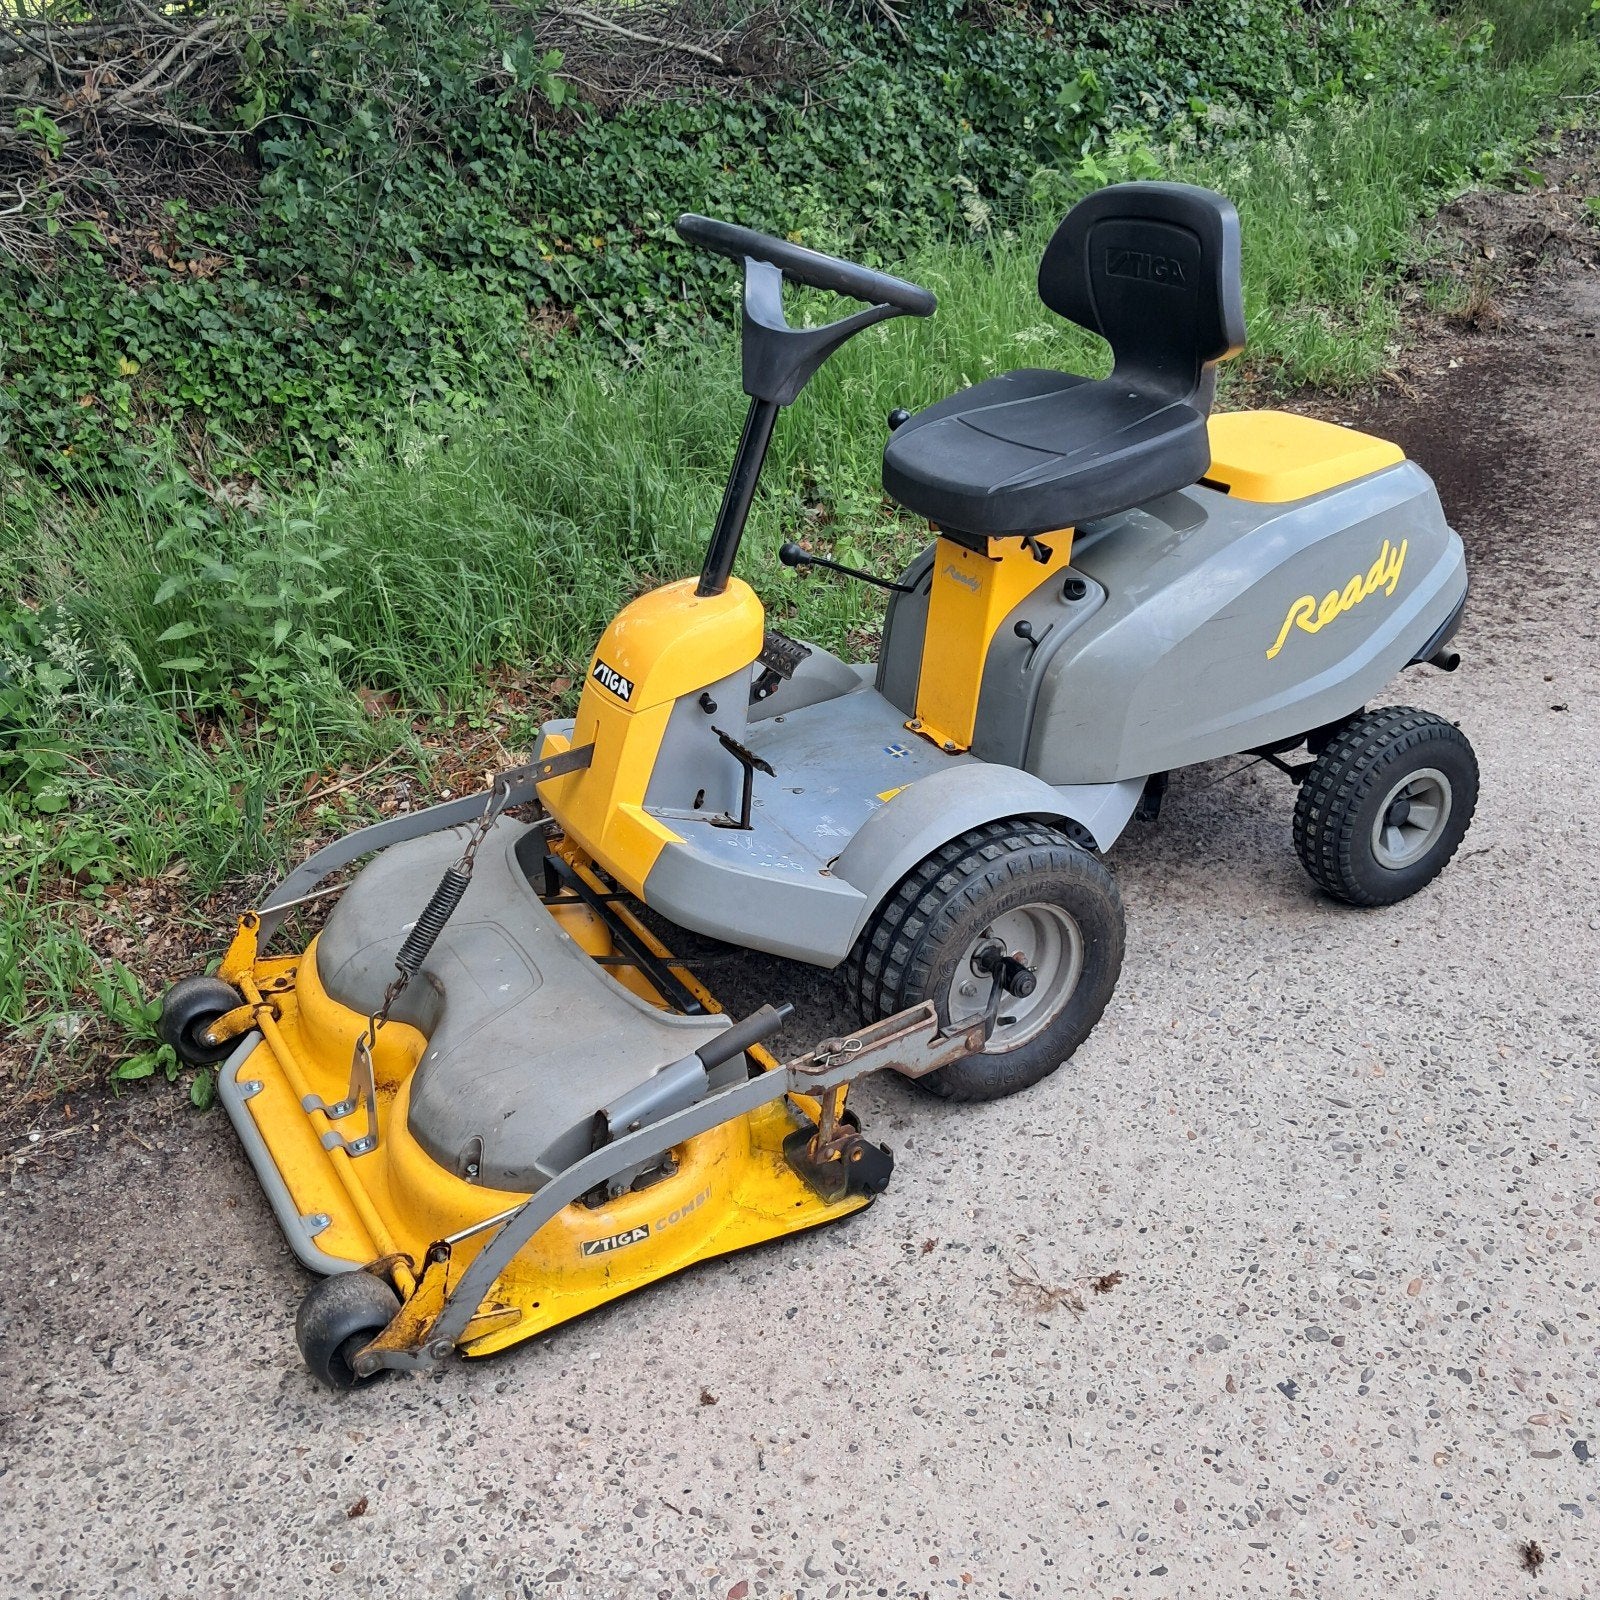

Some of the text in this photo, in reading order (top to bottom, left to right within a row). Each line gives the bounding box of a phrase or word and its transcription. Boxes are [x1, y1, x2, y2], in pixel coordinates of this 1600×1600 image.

[1107, 249, 1186, 284] STIGA
[944, 564, 981, 592] Ready
[1266, 538, 1408, 660] Ready
[593, 663, 629, 700] STIGA
[586, 1187, 711, 1255] STIGA COMBI
